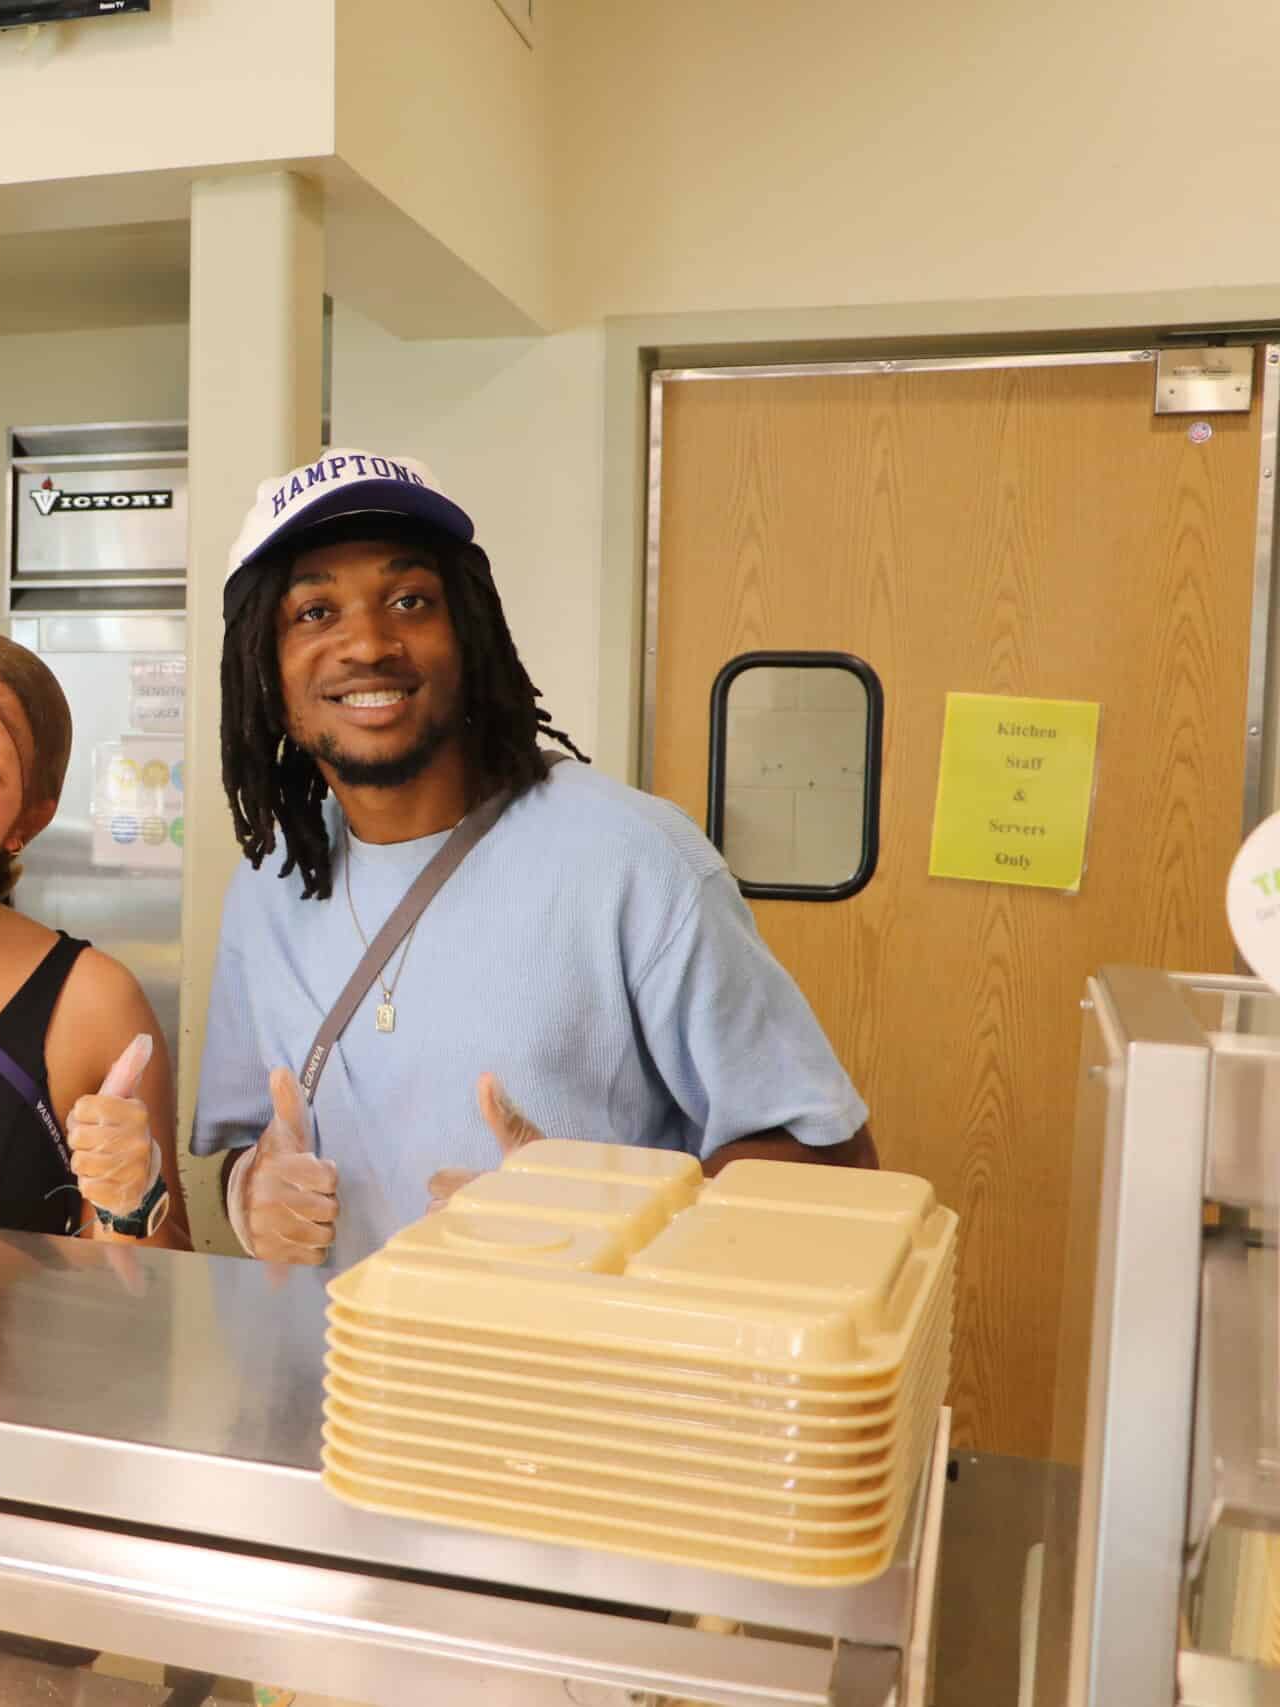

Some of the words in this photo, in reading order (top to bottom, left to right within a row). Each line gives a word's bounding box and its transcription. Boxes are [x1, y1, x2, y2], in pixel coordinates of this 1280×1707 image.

[31, 491, 169, 516] VICTORY
[996, 721, 1057, 739] Kitchen
[1006, 756, 1044, 770] Staff
[1013, 789, 1025, 802] &
[989, 819, 1046, 836] Servers
[995, 851, 1032, 870] Only
